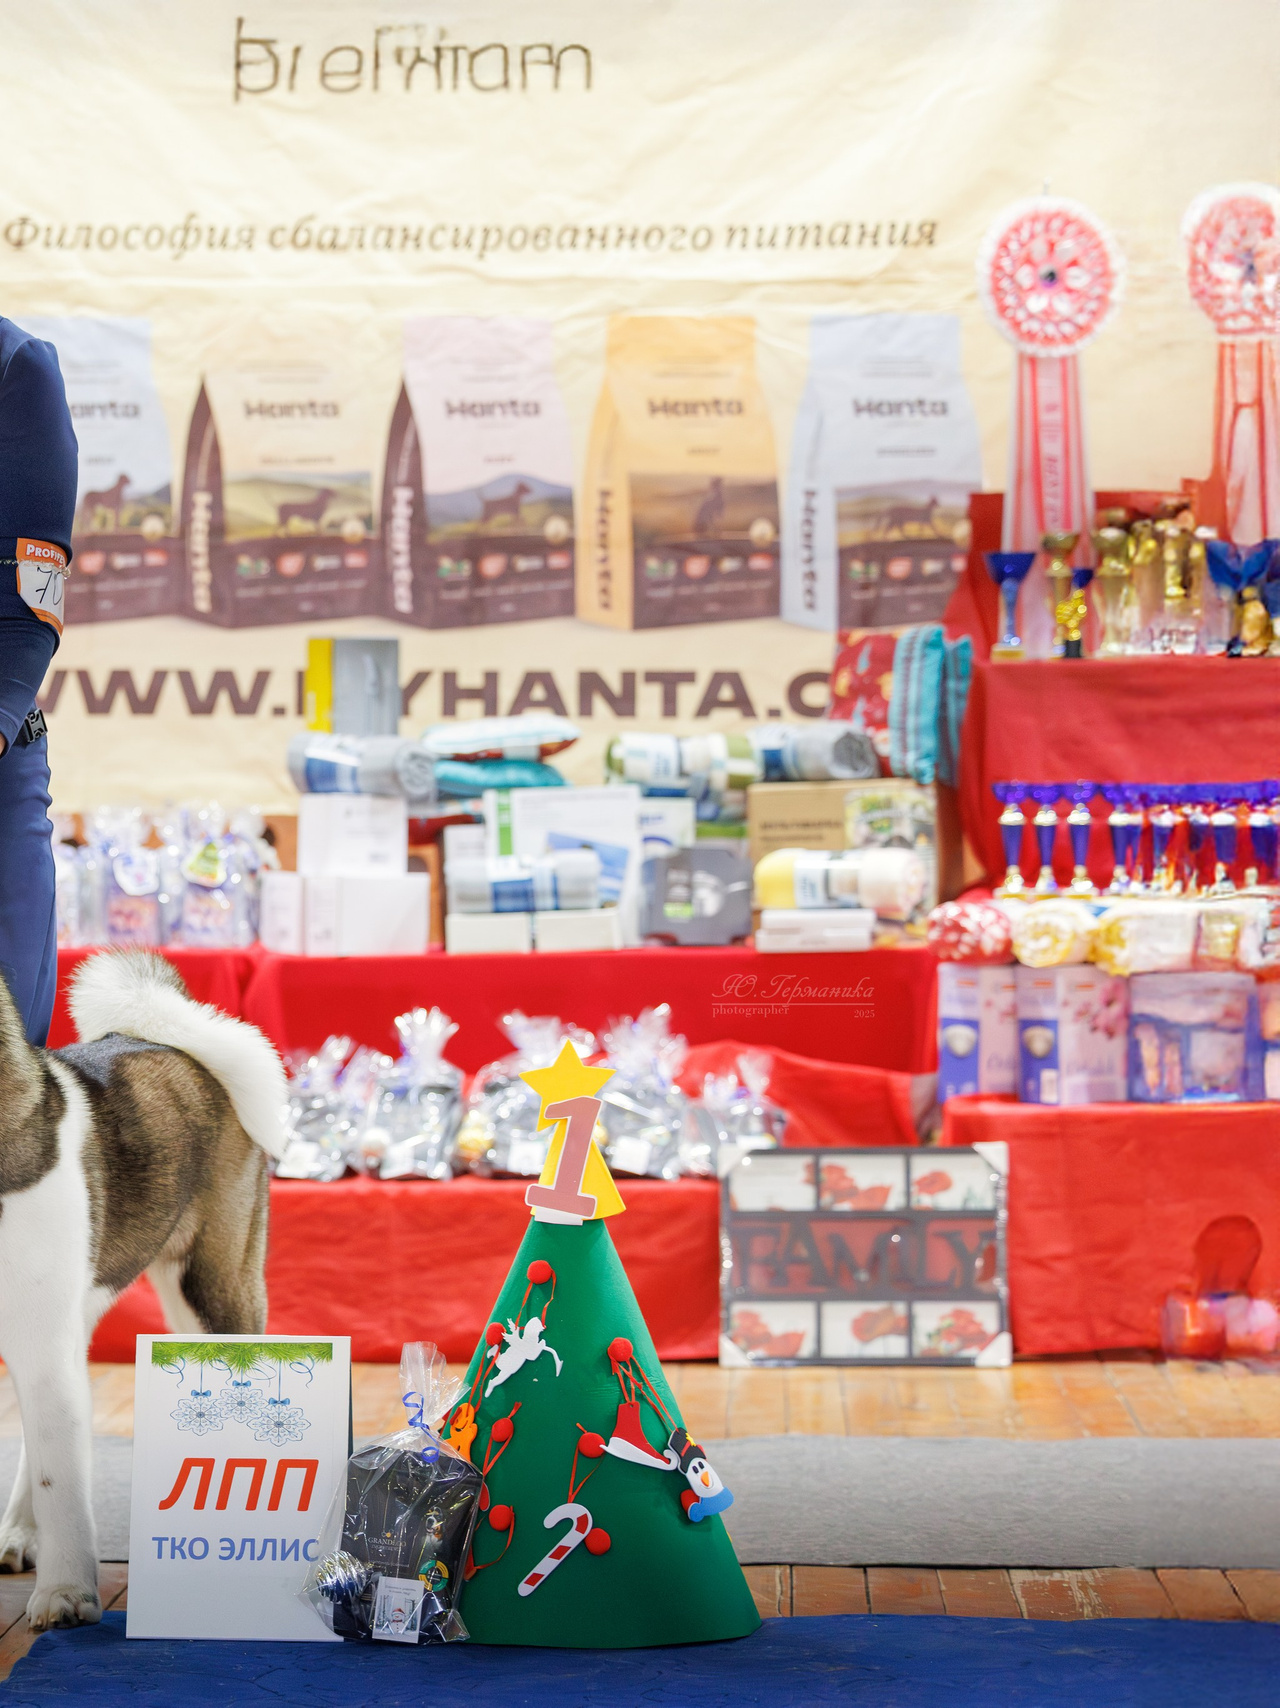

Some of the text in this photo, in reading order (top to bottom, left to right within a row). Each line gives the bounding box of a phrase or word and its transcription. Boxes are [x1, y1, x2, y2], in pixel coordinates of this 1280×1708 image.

[4, 214, 937, 261] Философия сбалансированного питания
[70, 400, 140, 419] anta
[445, 399, 541, 418] Hanta
[648, 398, 744, 416] Hanta
[852, 398, 948, 416] Hanta
[524, 1095, 602, 1218] 1
[158, 1458, 319, 1511] ЛПП
[152, 1536, 320, 1562] ТКО ЭЛЛИС
